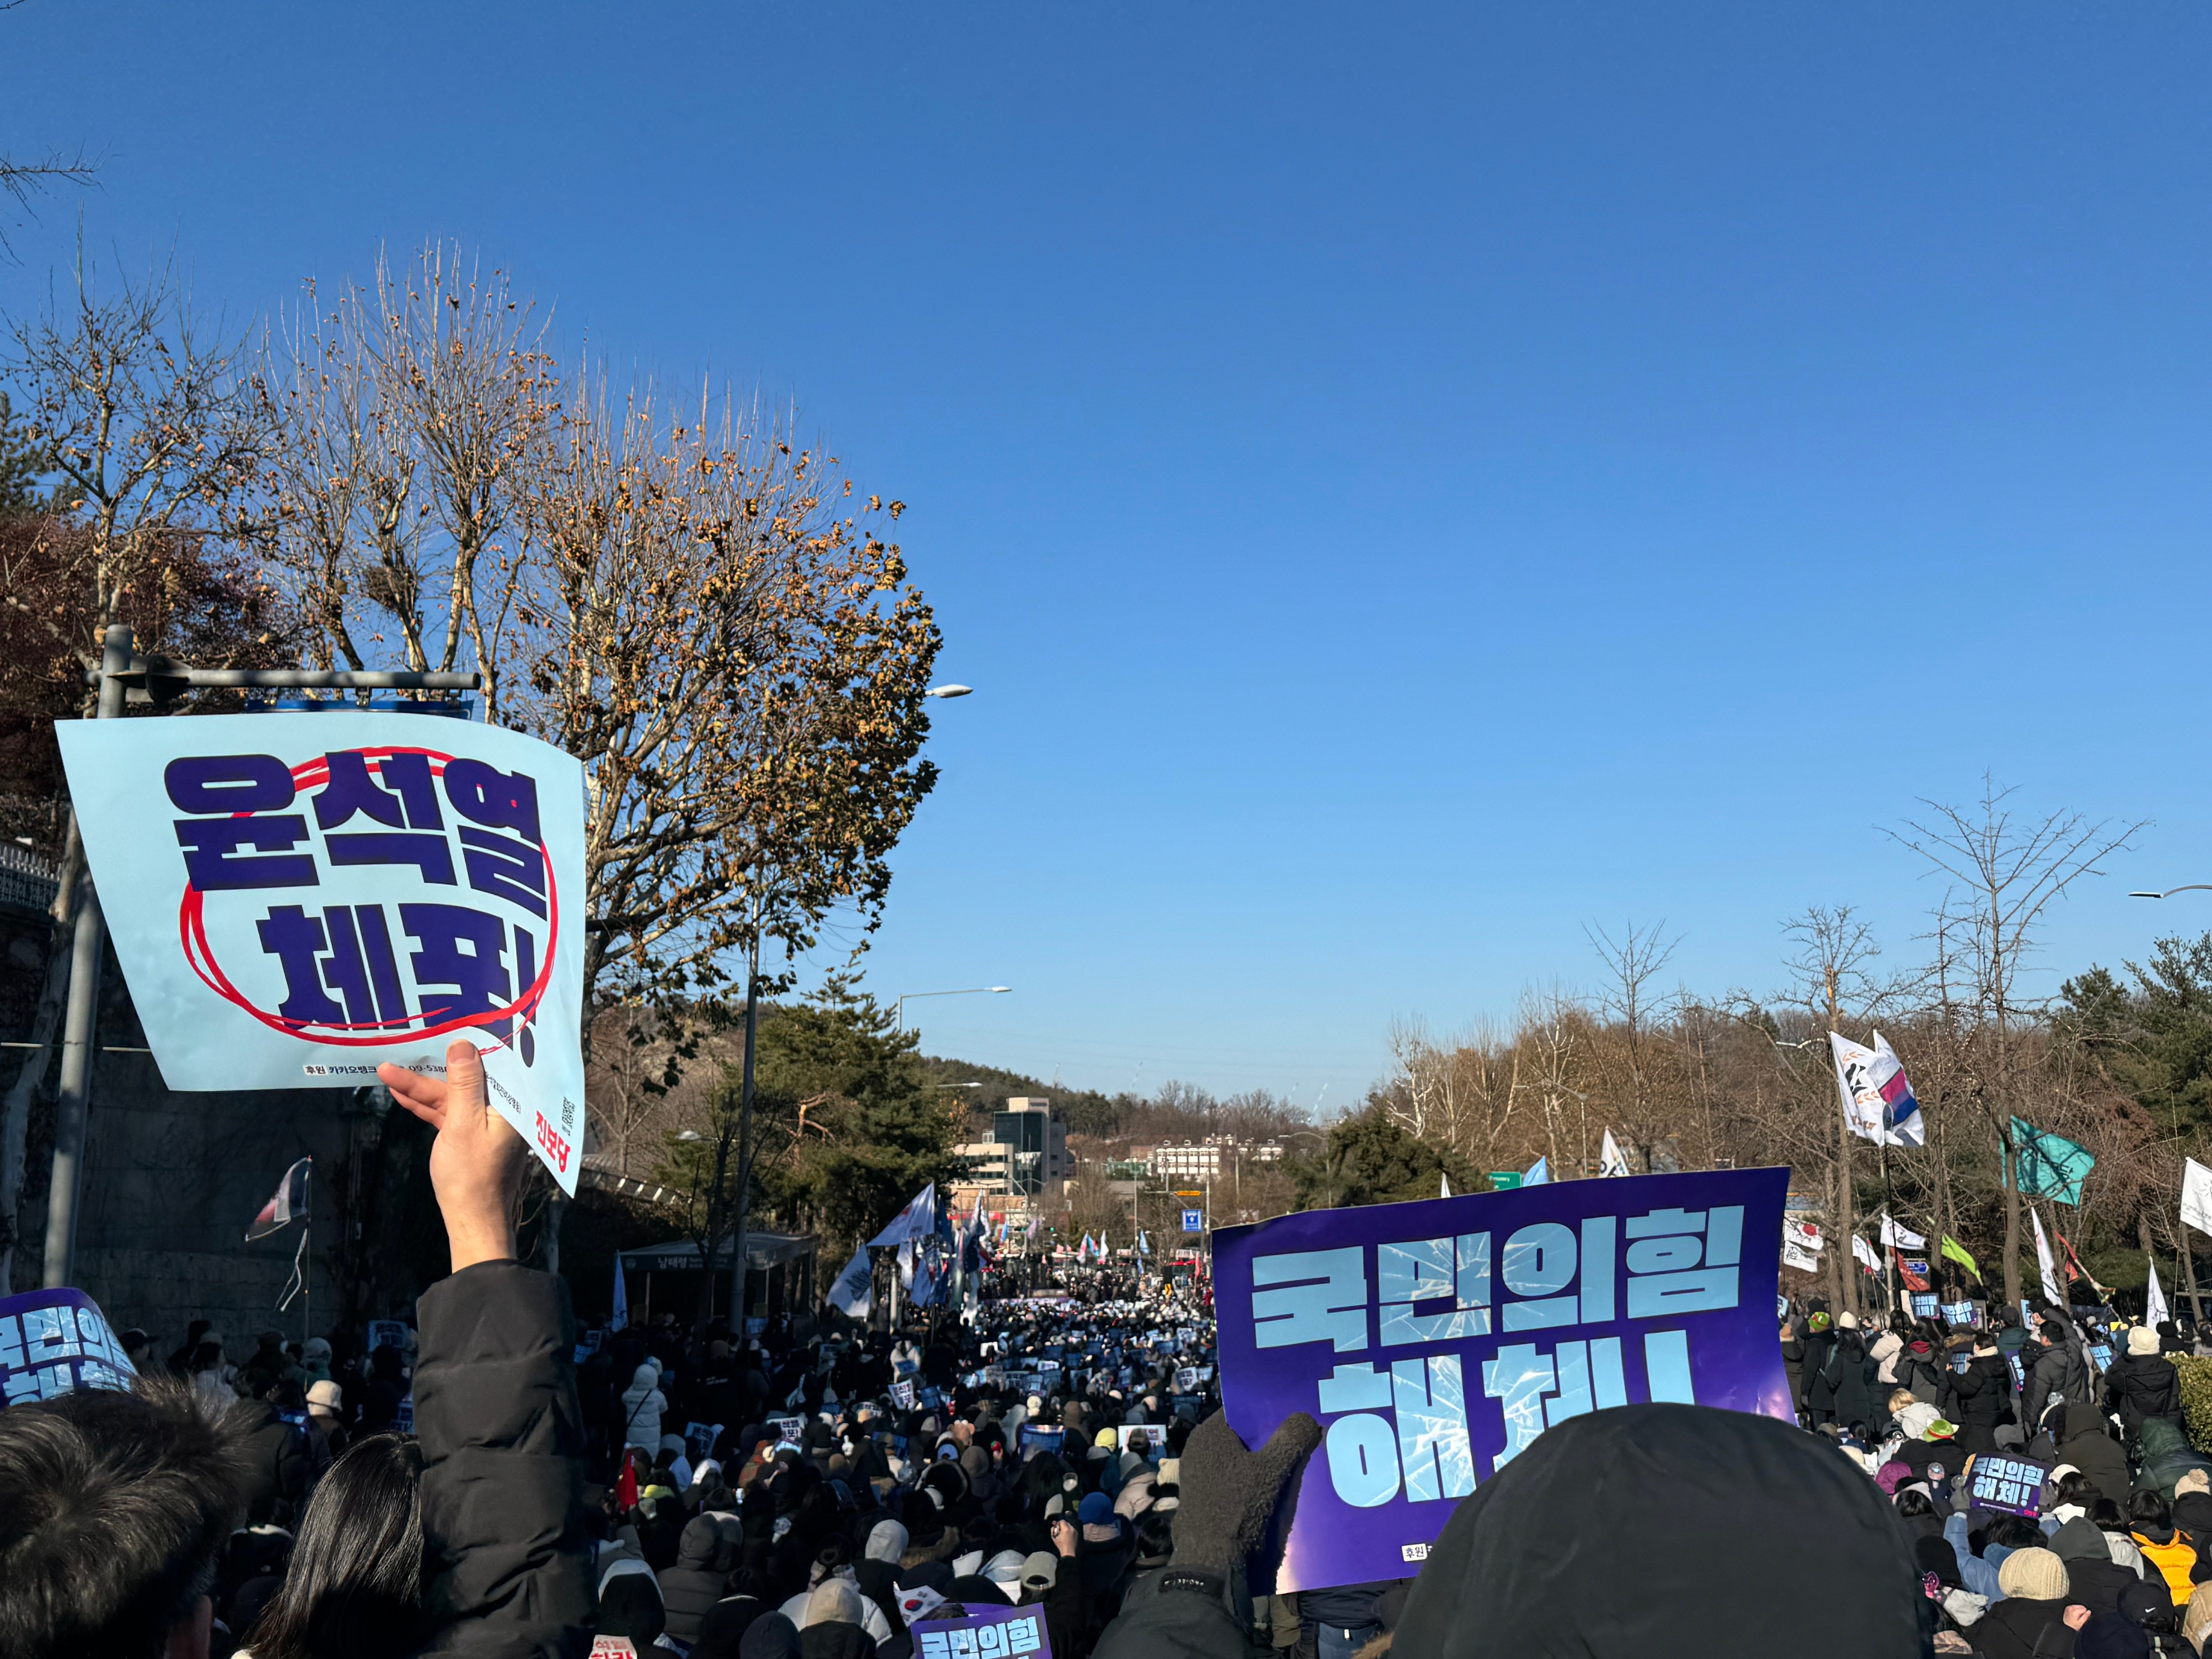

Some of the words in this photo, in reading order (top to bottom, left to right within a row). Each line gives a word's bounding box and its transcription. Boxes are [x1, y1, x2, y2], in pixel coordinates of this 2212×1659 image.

[163, 751, 547, 921] 윤석열
[256, 903, 537, 1068] 체포!
[305, 1066, 326, 1074] 후원
[329, 1065, 377, 1075] 카카오뱅크
[536, 1110, 571, 1173] 진보당
[658, 1256, 687, 1269] 남태령
[1252, 1205, 1745, 1352] 국민의힘
[1972, 1457, 2044, 1487] 국민의힘
[1973, 1475, 2031, 1507] 해체!
[1405, 1547, 1425, 1559] 후원
